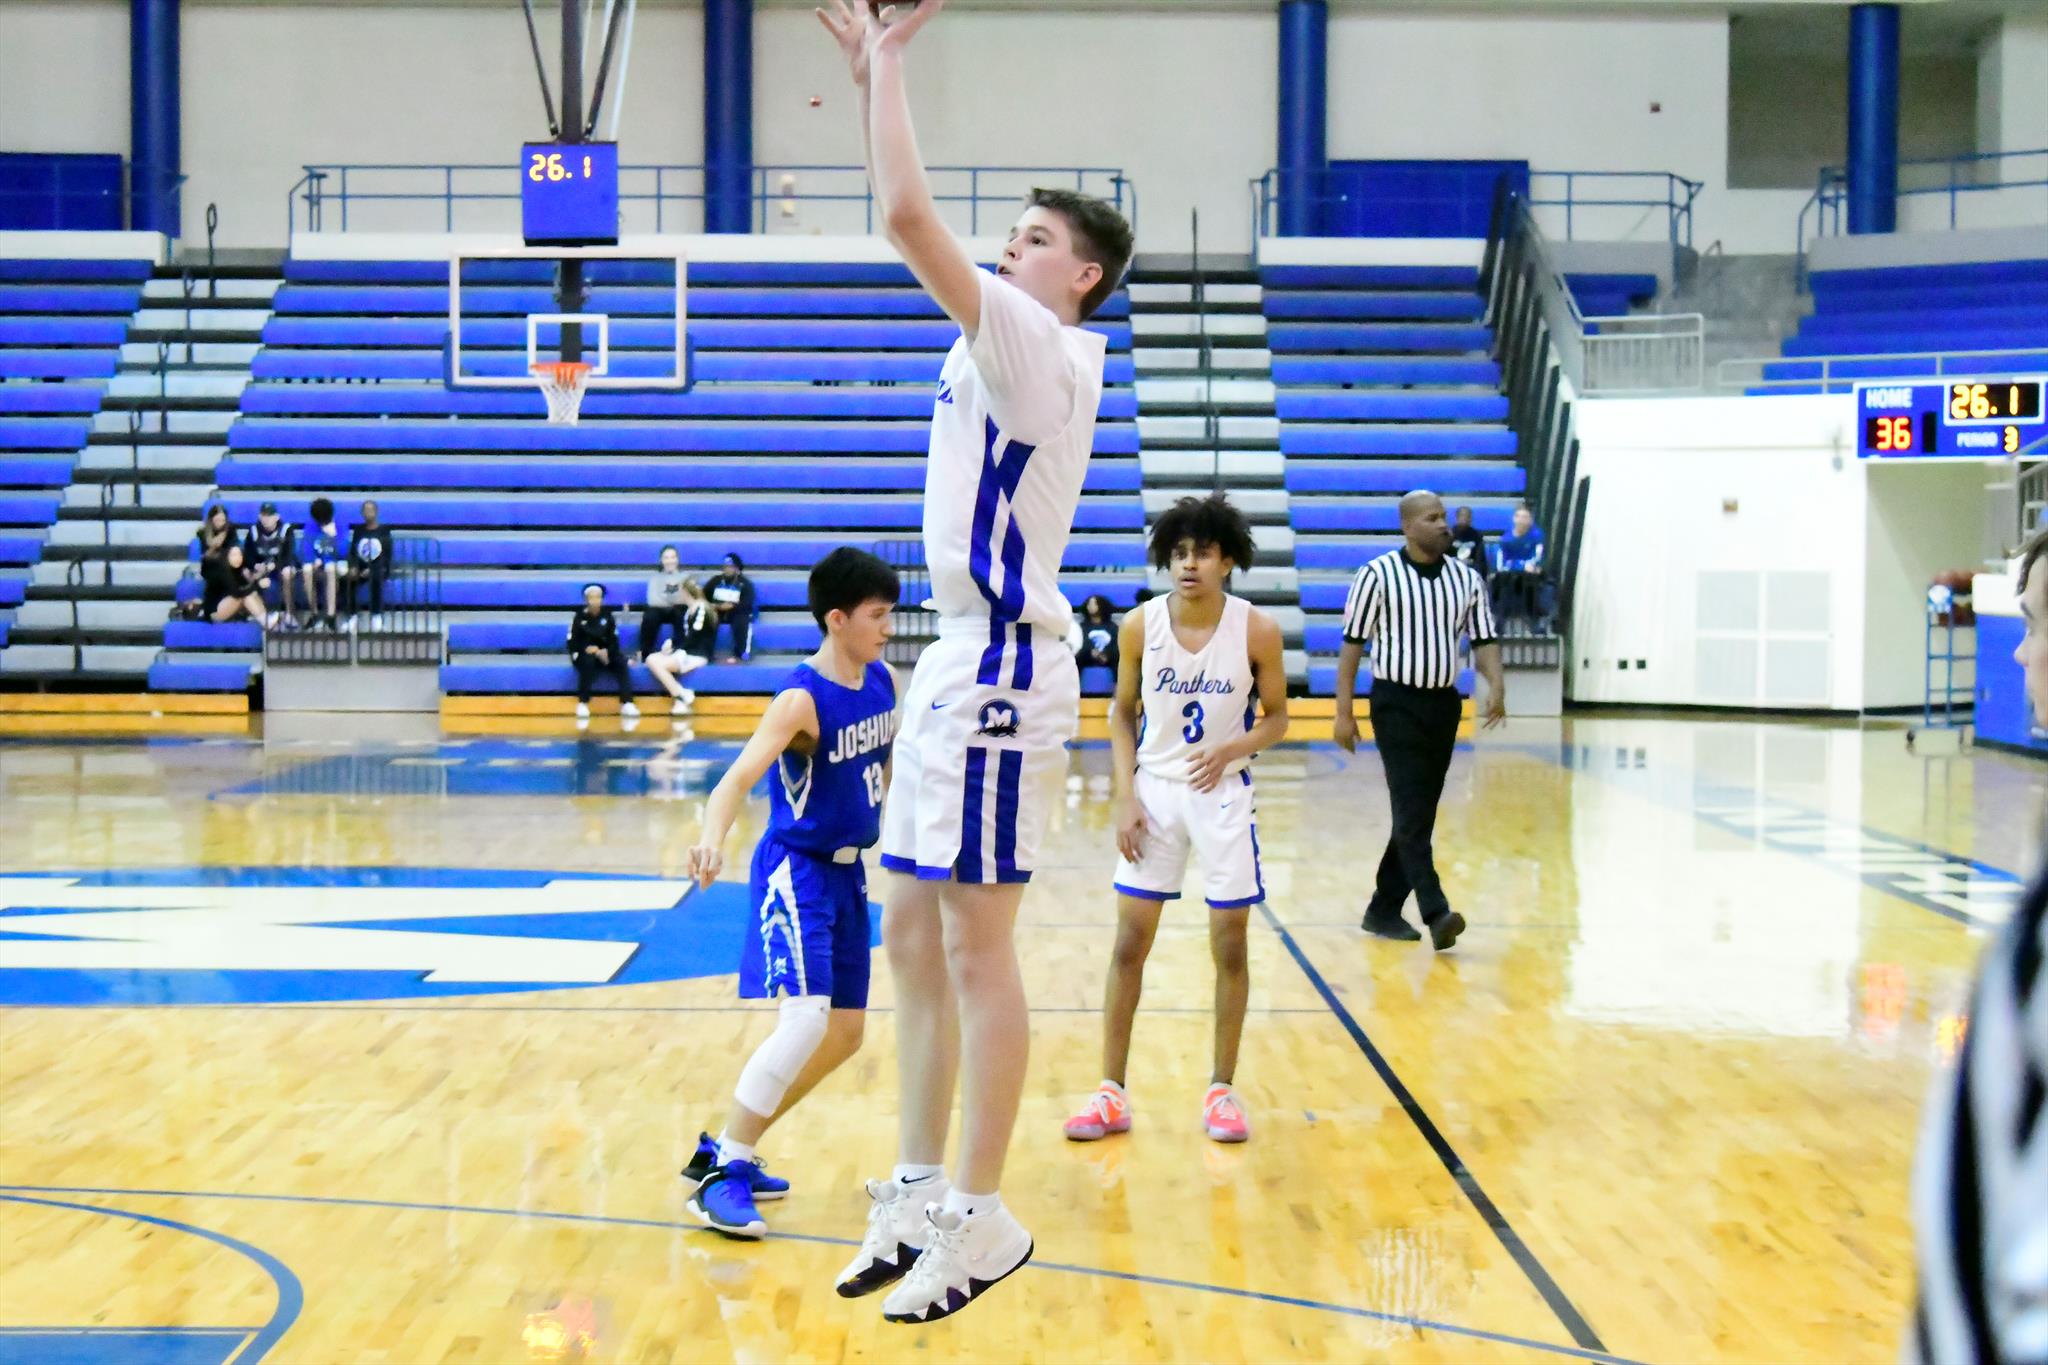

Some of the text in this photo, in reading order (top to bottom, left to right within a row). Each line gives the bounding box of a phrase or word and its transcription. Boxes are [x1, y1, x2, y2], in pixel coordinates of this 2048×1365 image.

[1866, 387, 1913, 408] HOME
[1877, 417, 1911, 450] 36
[2004, 425, 2019, 453] 3
[1155, 667, 1235, 694] Panthers
[1182, 700, 1204, 744] 3
[862, 761, 884, 808] 13
